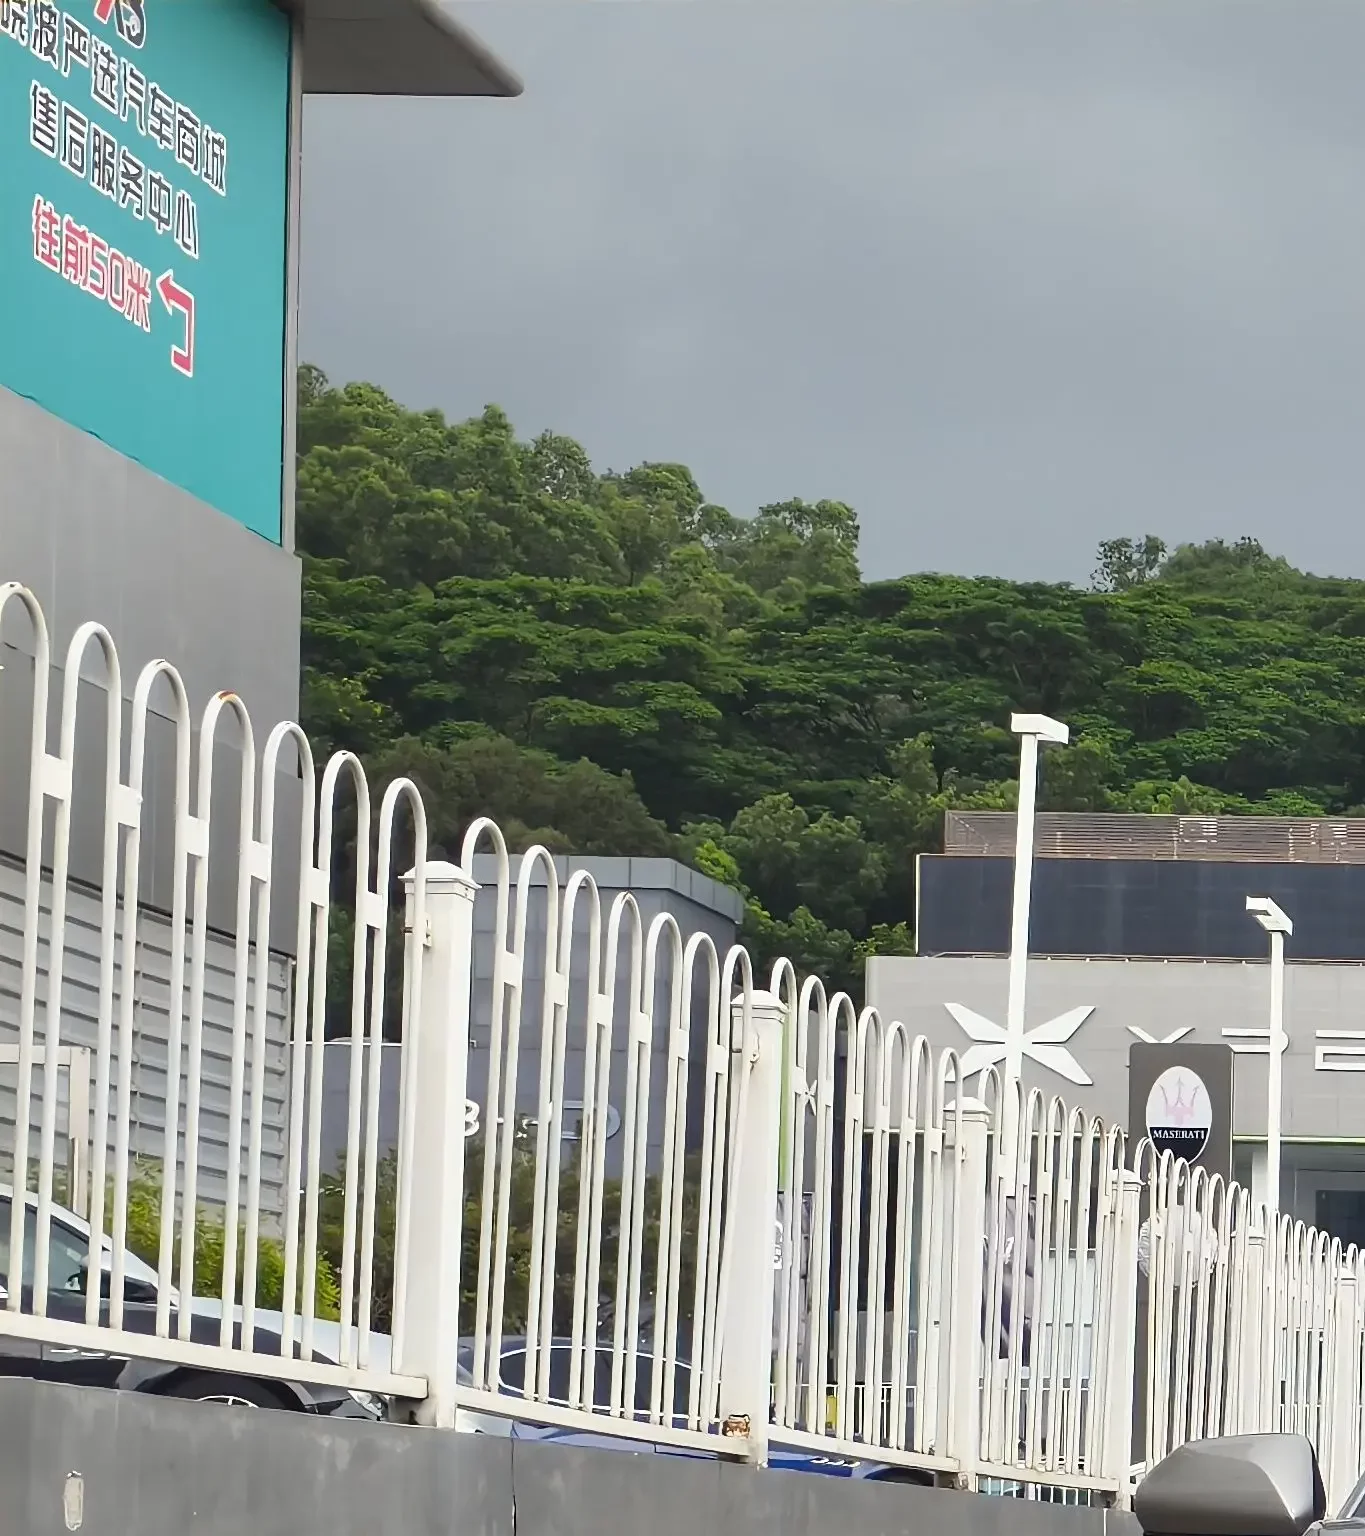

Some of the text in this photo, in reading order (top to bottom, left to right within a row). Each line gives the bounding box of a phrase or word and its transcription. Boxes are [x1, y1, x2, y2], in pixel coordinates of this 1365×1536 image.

[30, 79, 199, 259] 售后服务中心
[1152, 1128, 1205, 1140] MASERATI
